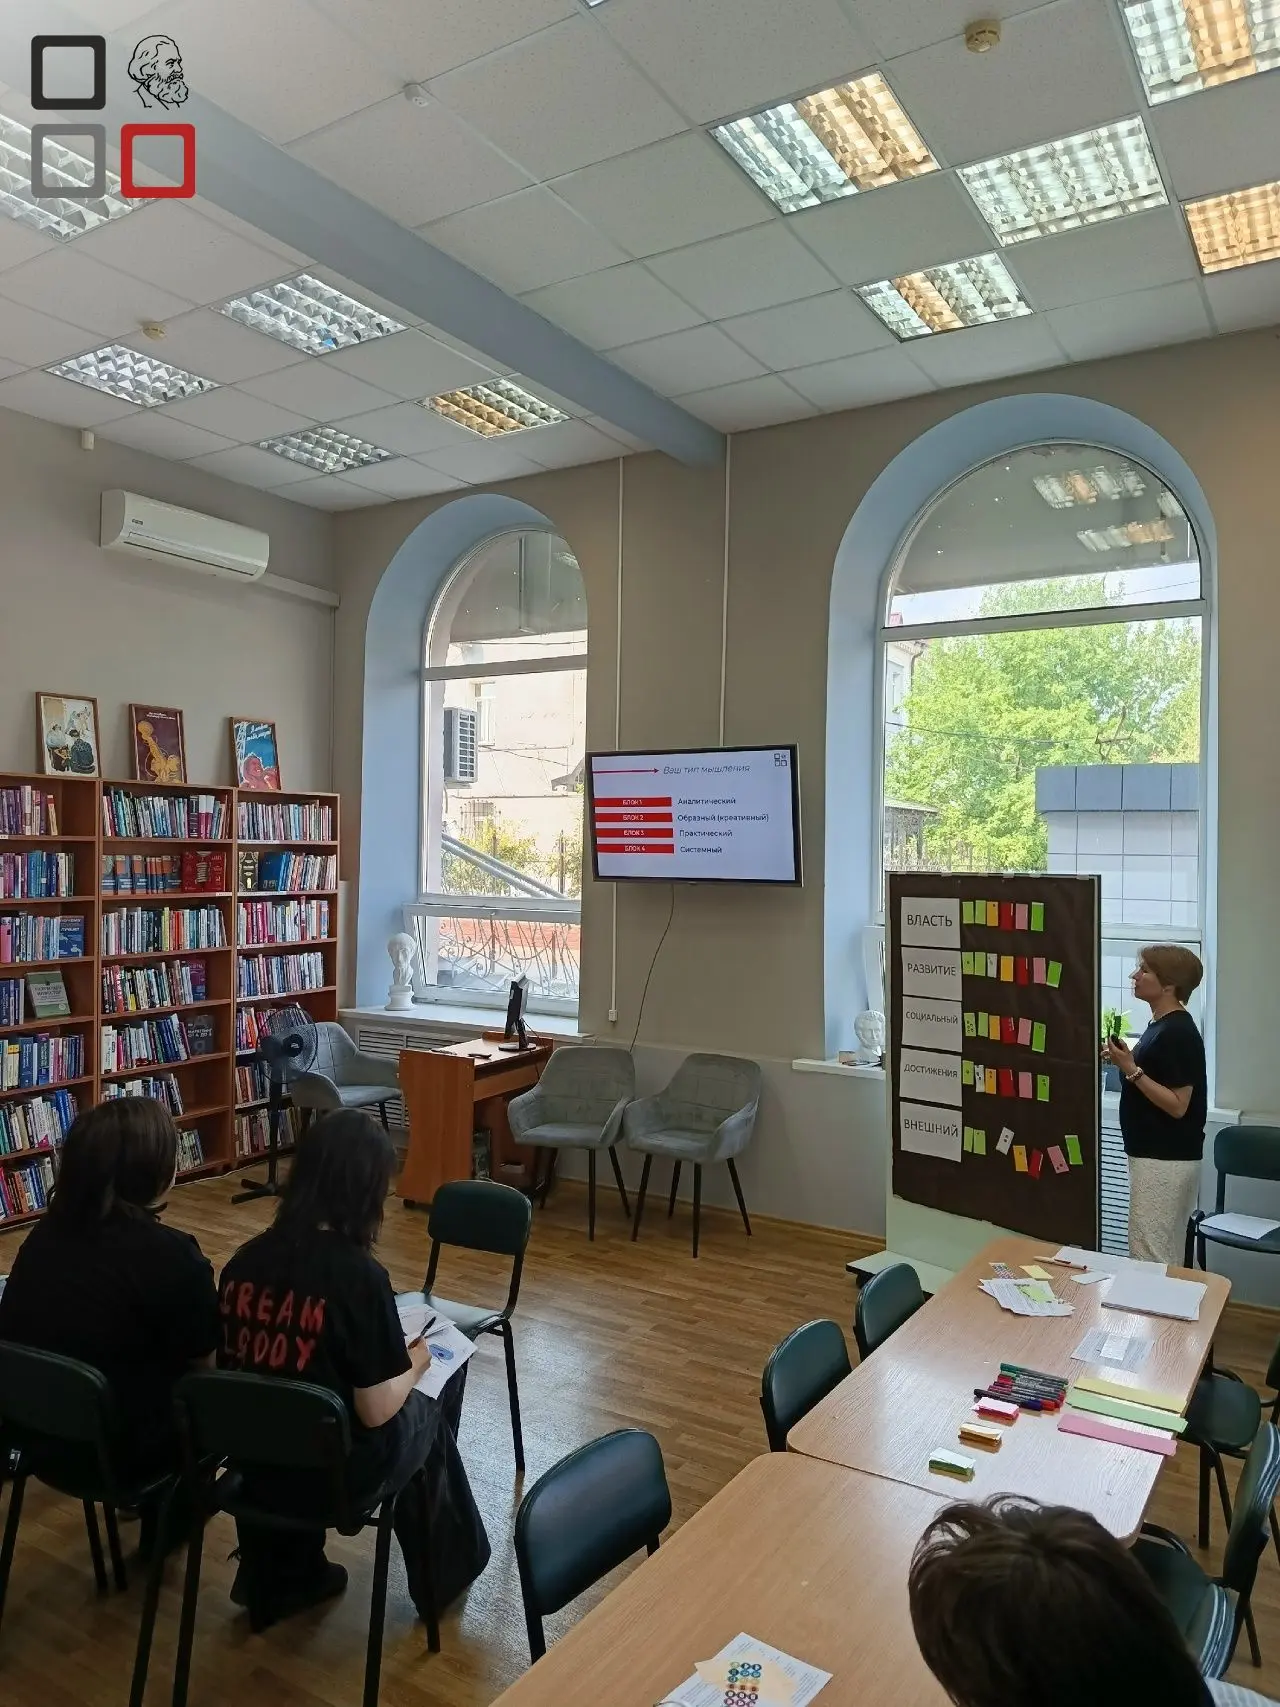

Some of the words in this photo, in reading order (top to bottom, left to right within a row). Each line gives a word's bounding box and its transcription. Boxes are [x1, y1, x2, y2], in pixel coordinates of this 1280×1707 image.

[663, 766, 681, 775] Ваш
[684, 766, 699, 774] тип
[701, 764, 750, 773] мышления
[677, 797, 736, 805] Аналитический
[677, 814, 715, 822] Образный
[717, 813, 769, 823] (креативный)
[679, 829, 733, 838] Практический
[680, 846, 722, 854] Системный
[907, 914, 953, 928] ВЛАСТЬ
[907, 963, 957, 977] РАЗВИТИЕ
[905, 1010, 958, 1025] СОЦИАЛЬНЫЙ
[903, 1063, 958, 1078] ДОСТИЖЕНИЯ
[904, 1118, 958, 1138] ВНЕШНИЙ
